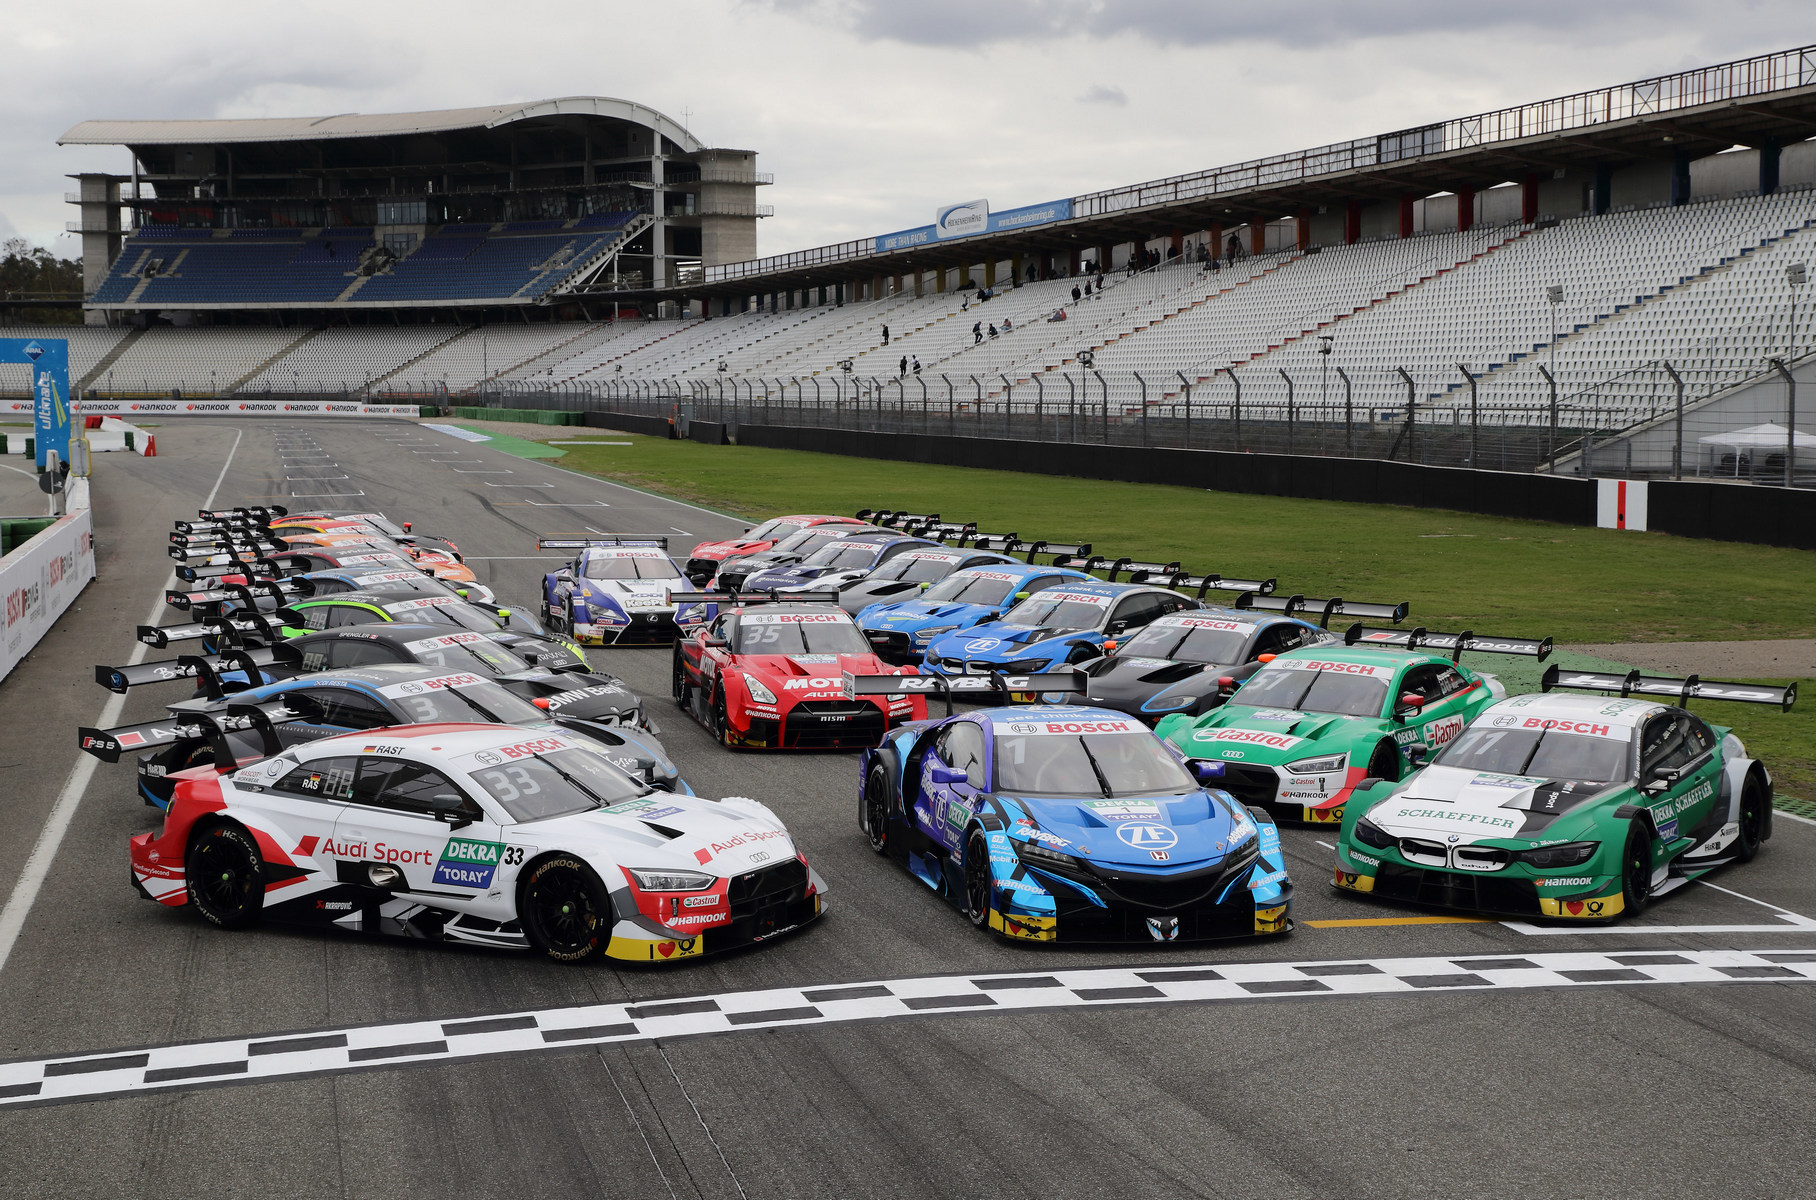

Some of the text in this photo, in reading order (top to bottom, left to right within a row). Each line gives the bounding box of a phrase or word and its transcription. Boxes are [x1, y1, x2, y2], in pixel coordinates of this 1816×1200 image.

[998, 209, 1055, 228] www.hockenheimring.de
[885, 232, 927, 249] MORE THAN RACING
[38, 371, 52, 430] ultimate
[810, 528, 839, 536] BOSCH
[912, 553, 950, 561] BOSCH
[50, 555, 60, 589] BOSCH
[384, 572, 421, 581] BOSCH
[972, 572, 1012, 581] BOSCH
[25, 581, 39, 613] REMUS
[417, 597, 455, 607] BOSCH
[1053, 593, 1100, 604] BOSCH
[7, 586, 21, 629] BOSCH
[780, 615, 838, 623] BOSCH
[1176, 613, 1243, 622] MOTORSPORT
[1181, 619, 1238, 631] BOSCH
[437, 633, 482, 646] BOSCH
[744, 625, 783, 645] 35
[967, 638, 993, 650] ZF
[1306, 661, 1375, 675] BOSCH
[423, 675, 480, 690] BOSCH
[783, 677, 844, 690] MOT
[898, 676, 1030, 689] RAYBRG
[1245, 671, 1292, 691] 51
[548, 680, 624, 712] BMW Bank
[411, 698, 439, 721] 3
[1006, 712, 1123, 722] see. think. act.
[1045, 722, 1129, 734] BOSCH
[1434, 718, 1462, 746] Castrol
[1522, 717, 1610, 736] BOSCH
[1217, 728, 1295, 749] Castrol
[1398, 728, 1419, 744] DEKRA
[1454, 729, 1509, 755] 11
[376, 745, 406, 756] RAST
[500, 738, 567, 759] BOSCH
[1003, 737, 1026, 765] 1
[237, 776, 260, 784] WORKWEAR
[302, 778, 319, 790] RAS
[483, 765, 542, 803] 33
[1295, 778, 1316, 786] Castrol
[1545, 791, 1559, 809] sport
[1674, 780, 1714, 814] SCHAEFFLER
[948, 804, 966, 828] DEKRA
[1397, 808, 1515, 829] SCHAEFFLER
[1654, 804, 1675, 823] DEKRA
[710, 829, 785, 855] Audi Sport
[1120, 826, 1169, 845] ZF
[321, 837, 432, 866] Audi Sport
[448, 841, 498, 862] DEKRA
[504, 846, 525, 866] 33
[989, 855, 1011, 863] Mobil
[692, 896, 718, 907] Castrol
